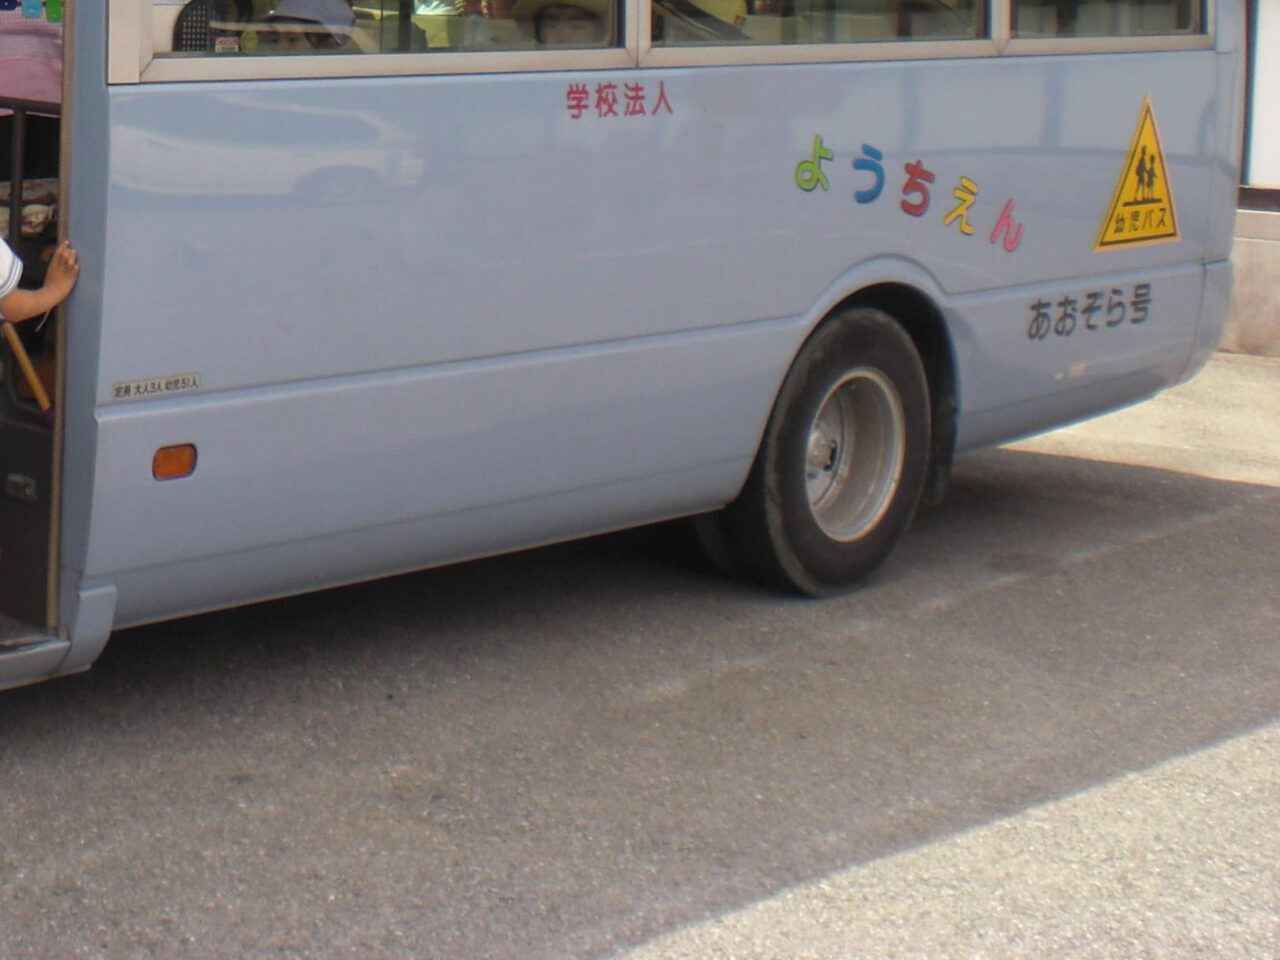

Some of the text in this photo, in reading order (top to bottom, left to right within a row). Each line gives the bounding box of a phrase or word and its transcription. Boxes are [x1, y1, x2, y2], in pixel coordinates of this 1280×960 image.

[566, 80, 674, 119] 学校法人
[794, 133, 1025, 252] ようちえん
[1113, 207, 1168, 233] 幼児バス
